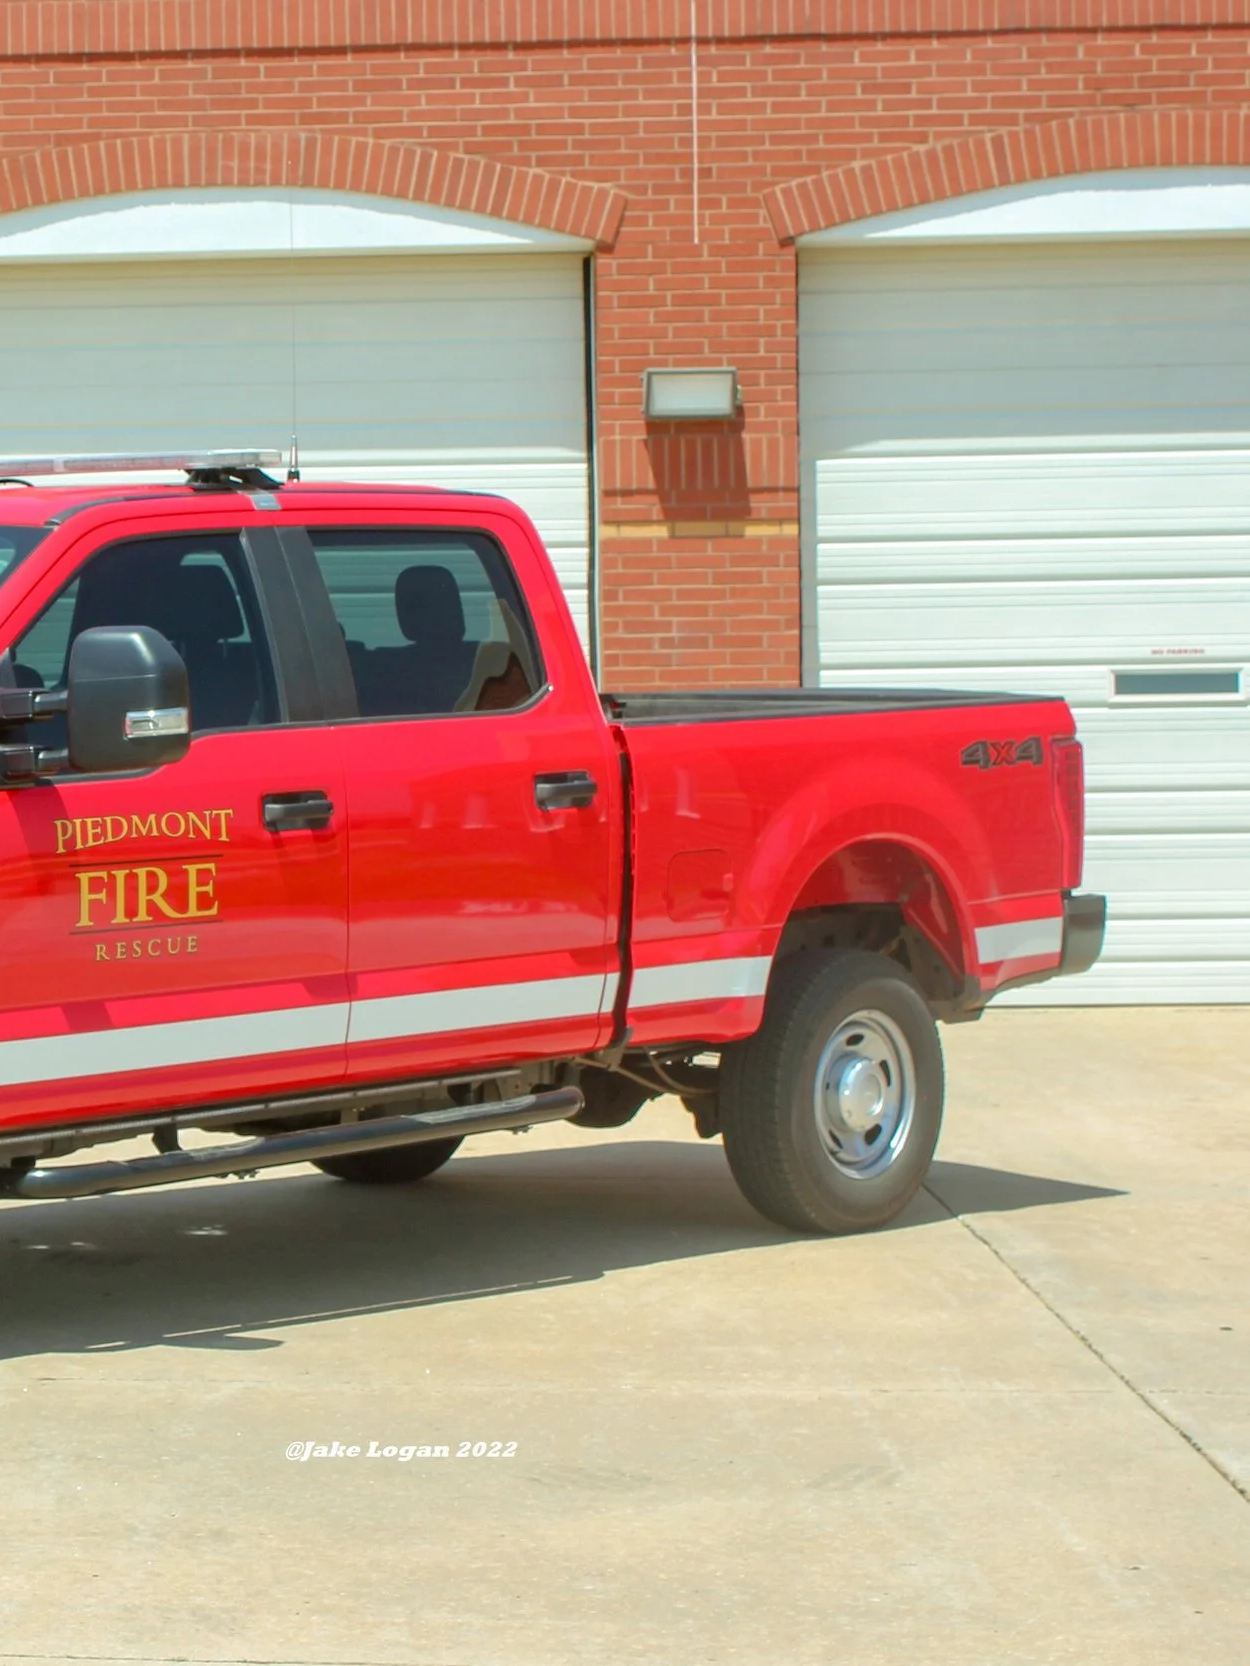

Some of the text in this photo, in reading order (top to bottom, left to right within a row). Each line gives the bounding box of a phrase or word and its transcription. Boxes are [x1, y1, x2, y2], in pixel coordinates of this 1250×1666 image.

[54, 809, 234, 853] PIEDMONT
[75, 863, 218, 928] FIRE
[95, 936, 199, 961] RESCUE
